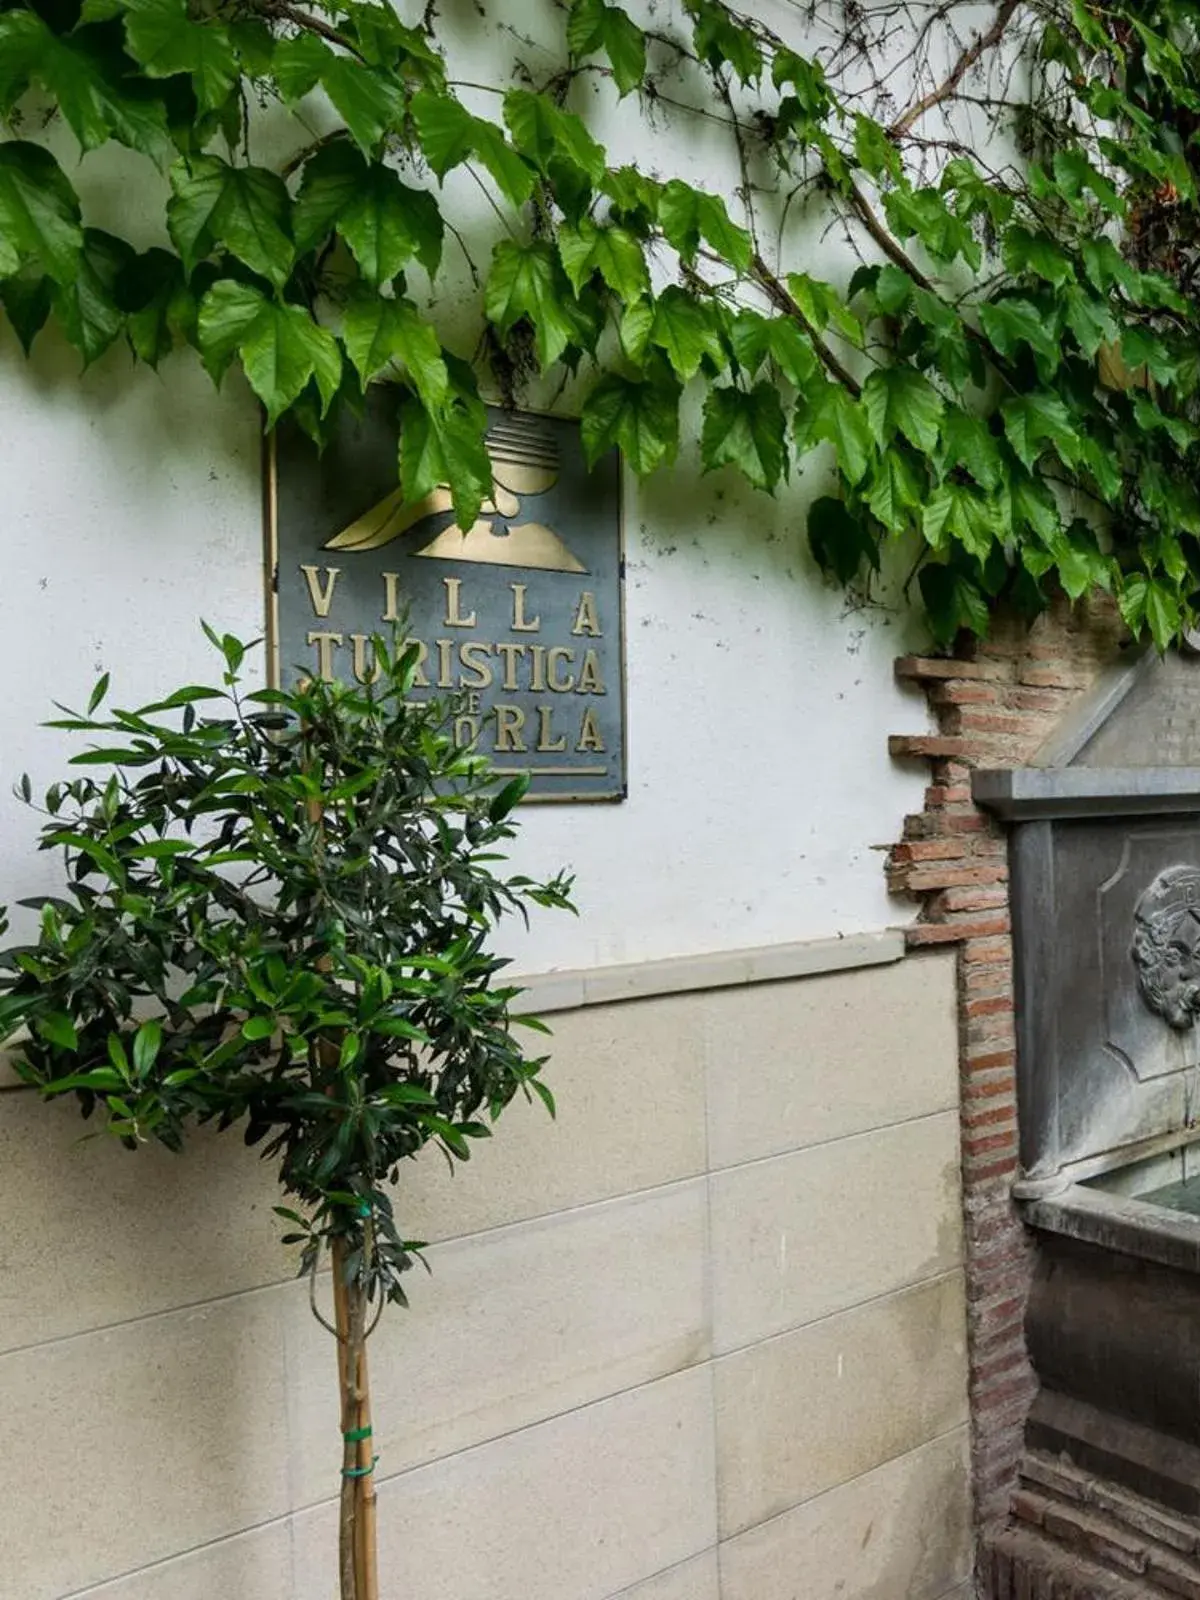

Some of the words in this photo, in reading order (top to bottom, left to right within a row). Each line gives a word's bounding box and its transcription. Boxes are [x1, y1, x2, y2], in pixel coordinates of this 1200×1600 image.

[300, 565, 603, 637] VILLA
[307, 632, 606, 695] TURISTICA
[345, 701, 605, 752] ORLA
